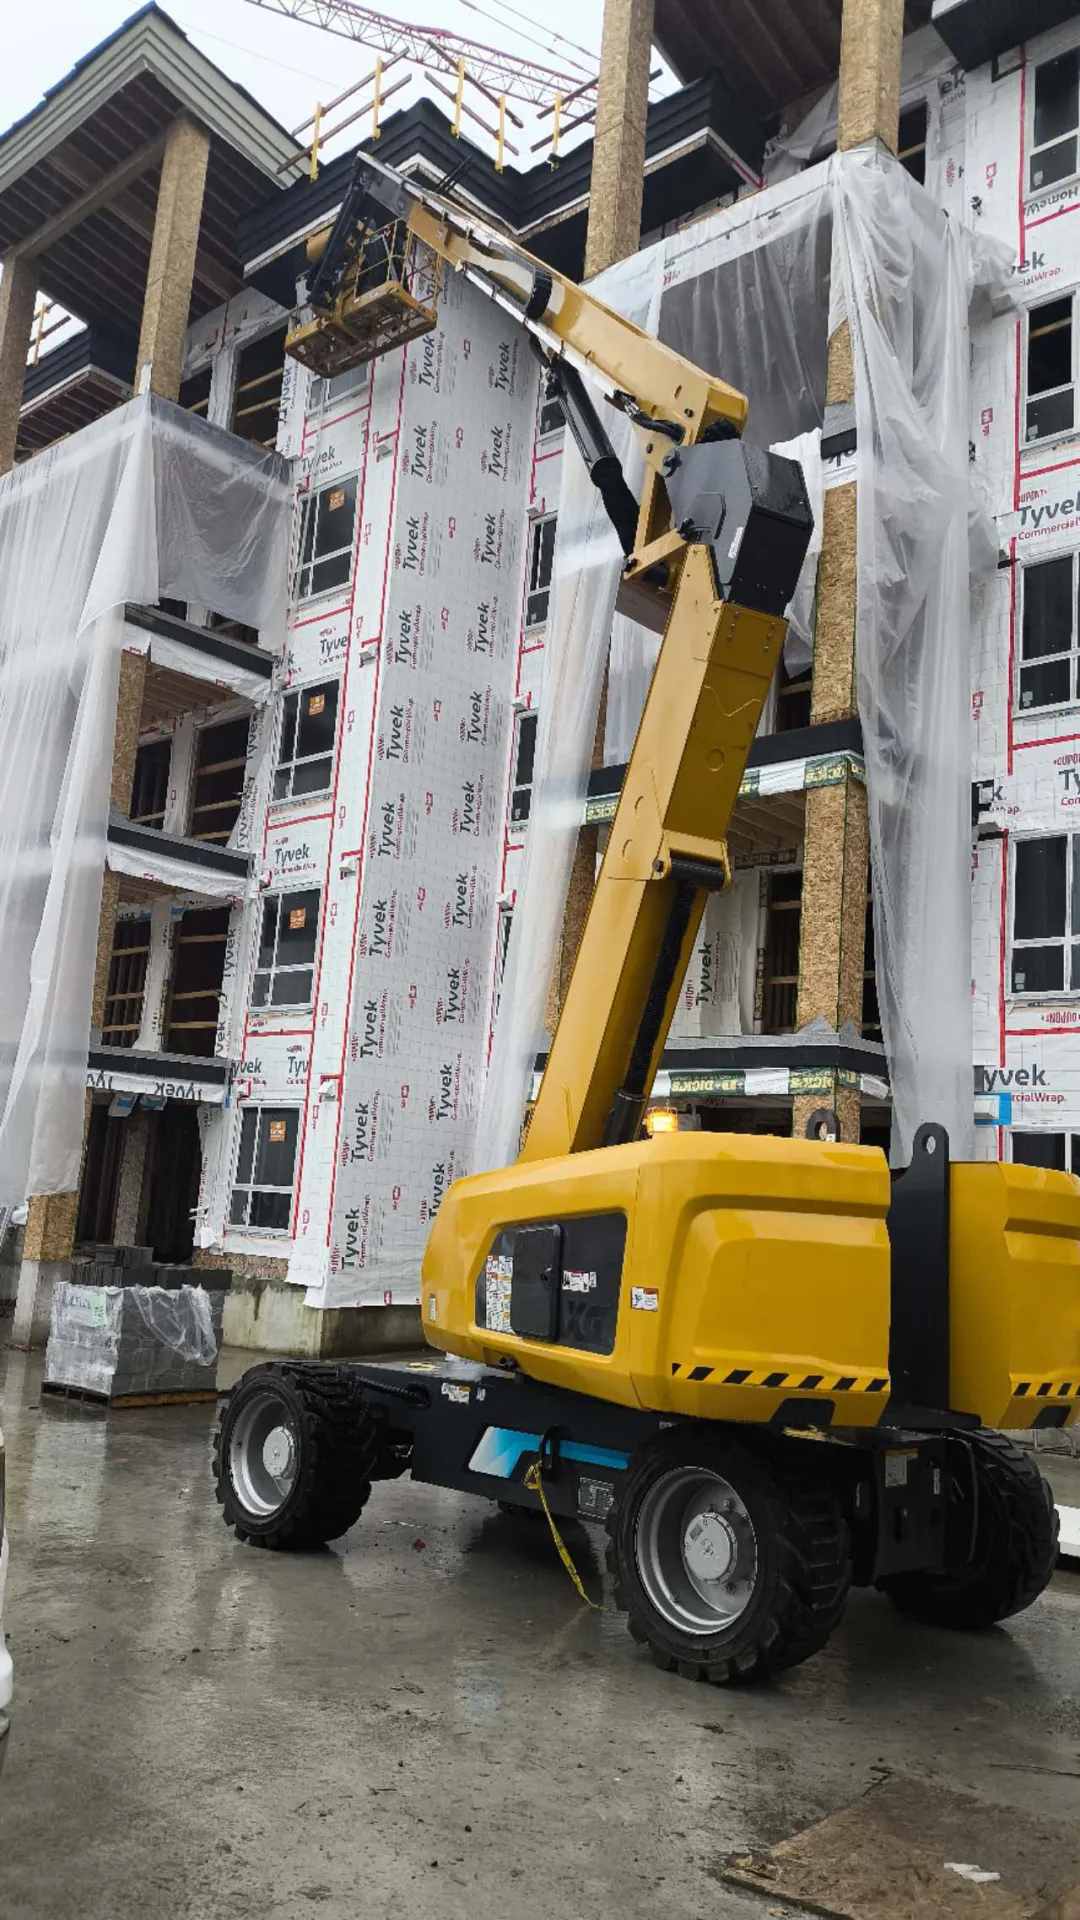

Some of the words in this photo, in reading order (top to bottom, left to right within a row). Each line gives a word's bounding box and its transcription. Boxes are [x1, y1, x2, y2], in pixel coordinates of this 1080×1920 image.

[419, 335, 435, 387] Tyvek
[495, 341, 511, 391] Tyvek
[411, 424, 428, 478] Tyvek
[488, 425, 503, 478] Tyvek
[403, 516, 420, 571] Tyvek
[481, 512, 496, 565] Tyvek
[1018, 515, 1080, 541] Commercial
[319, 635, 348, 656] Tyve
[394, 610, 412, 665] Tyvek
[474, 601, 489, 654] Tyvek
[387, 705, 404, 762] Tyvek
[467, 691, 483, 743] Tyvek
[377, 800, 397, 857] Tyvek
[459, 780, 475, 834] Tyvek
[274, 843, 311, 867] Tyvek
[451, 871, 469, 928] Tyvek
[368, 898, 388, 957] Tyvek
[443, 966, 460, 1023] Tyvek
[696, 941, 713, 1006] Tyvek
[360, 998, 378, 1059] Tyvek
[231, 1057, 262, 1078] yvek
[436, 1063, 453, 1121] Tyvek
[983, 1063, 1047, 1092] yvek
[1011, 1092, 1065, 1105] rcialWrap
[350, 1102, 370, 1163] Tyvek
[341, 1207, 360, 1270] Tyvek
